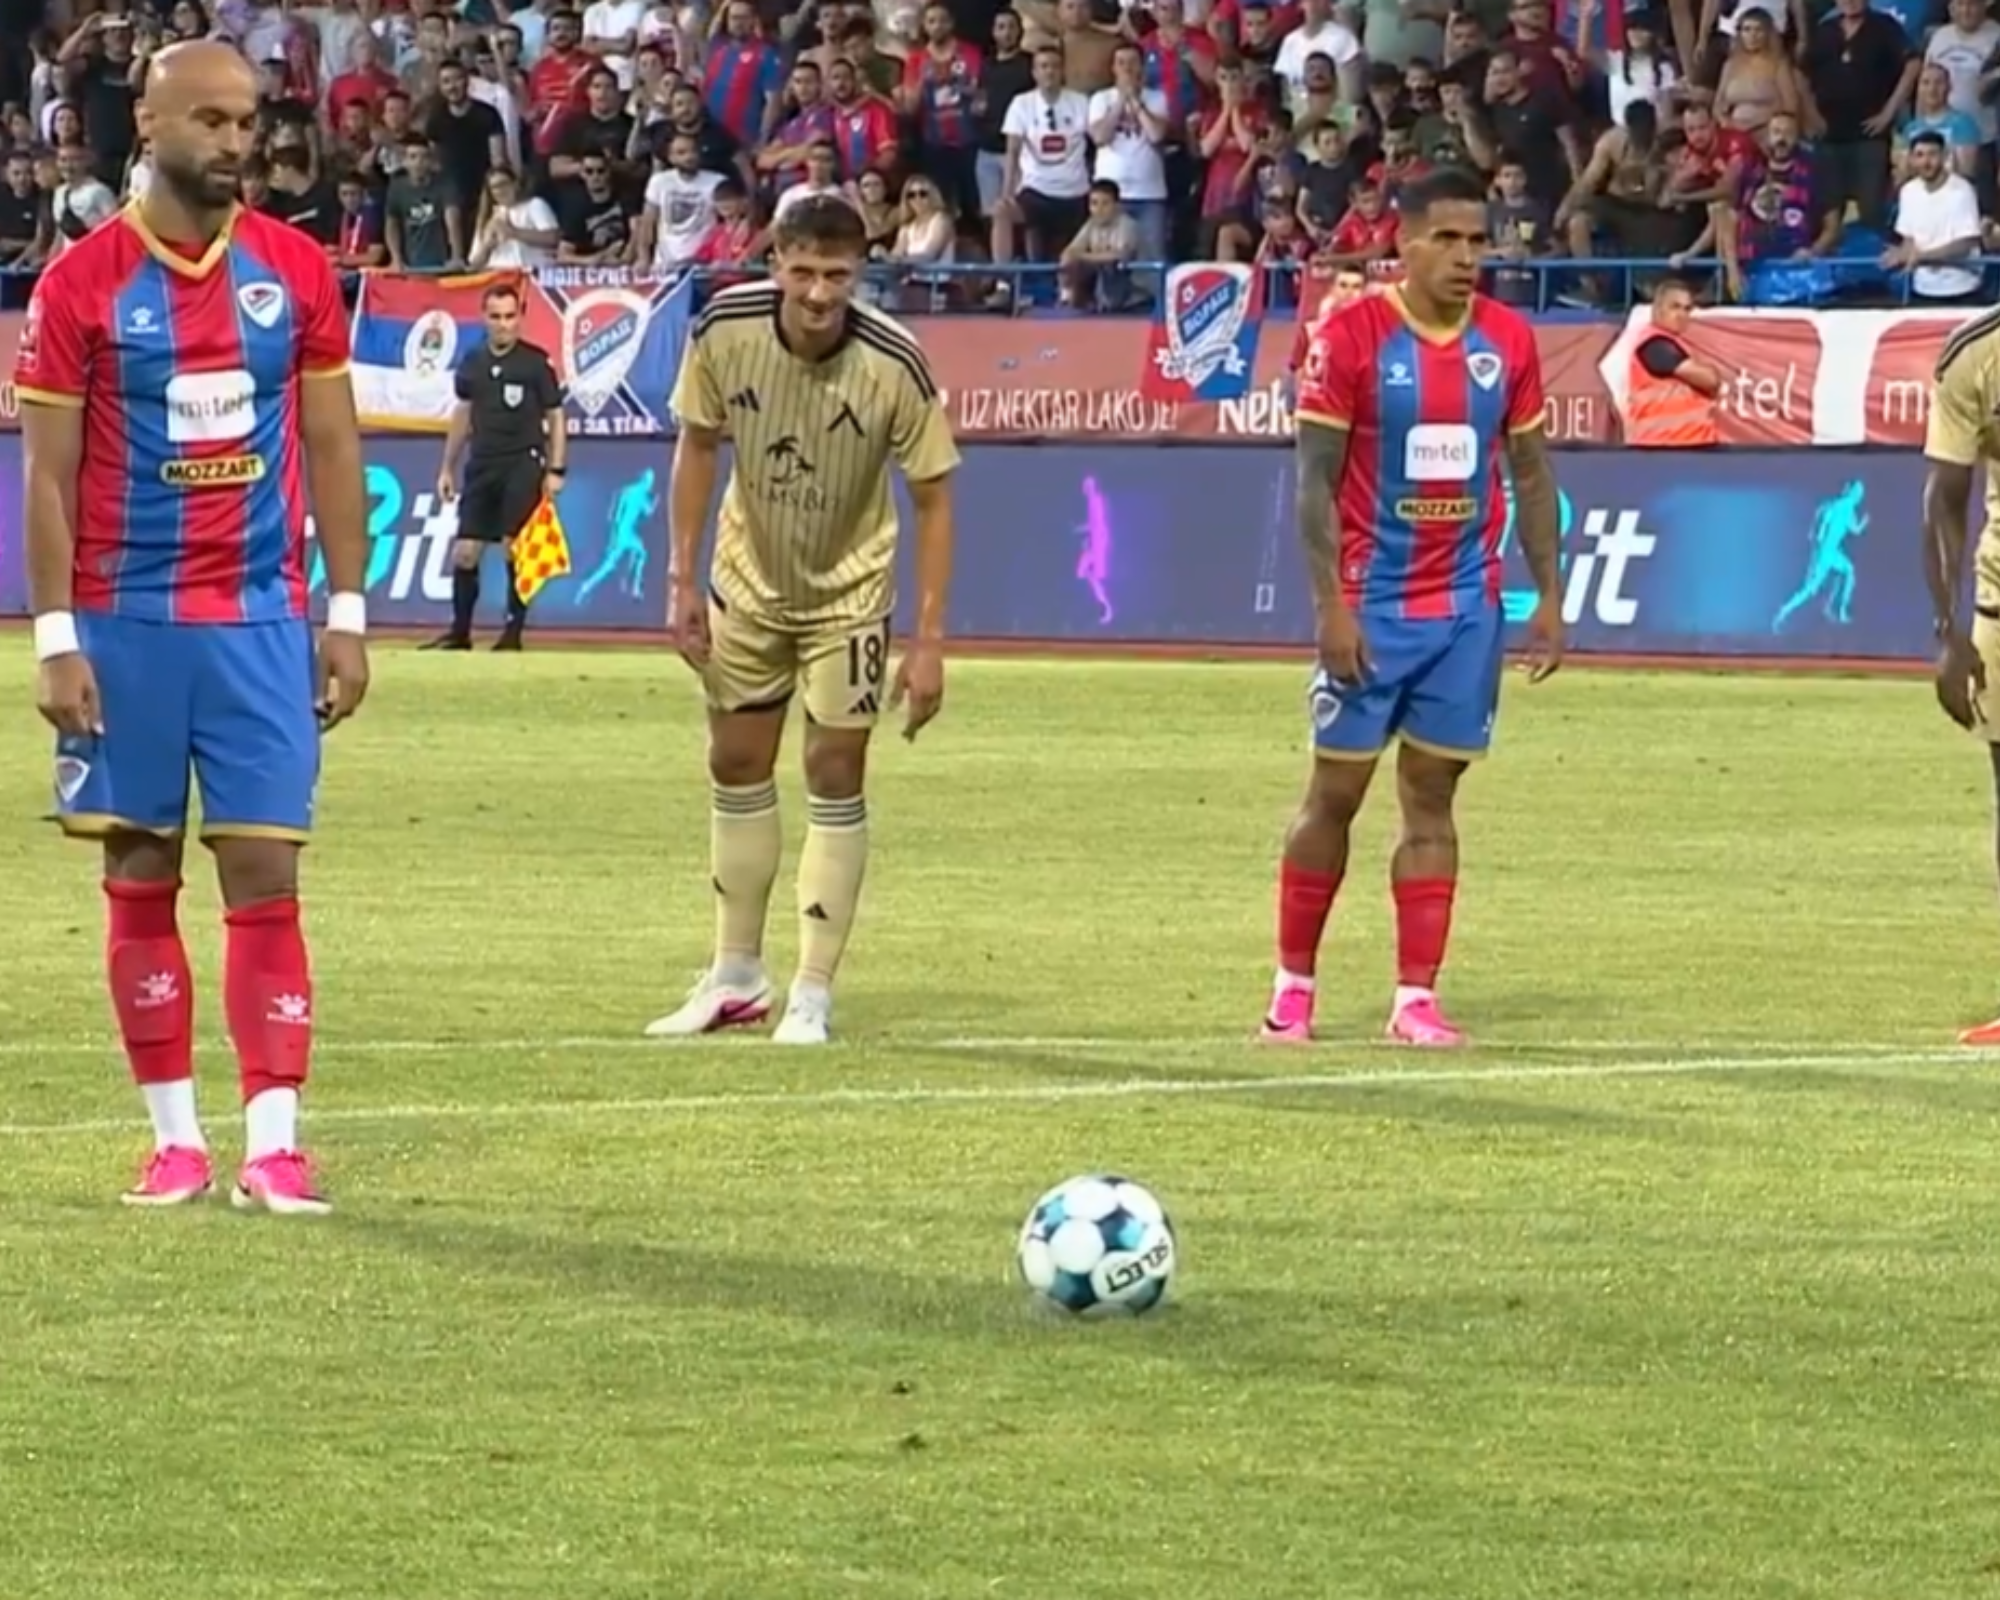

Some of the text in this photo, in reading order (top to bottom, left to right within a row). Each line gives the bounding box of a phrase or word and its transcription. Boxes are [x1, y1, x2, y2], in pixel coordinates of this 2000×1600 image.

[960, 389, 992, 429] UZ
[995, 388, 1079, 430] NEKTAR
[1085, 389, 1146, 431] LAKO
[166, 458, 258, 480] MOZZART
[848, 634, 882, 687] 18
